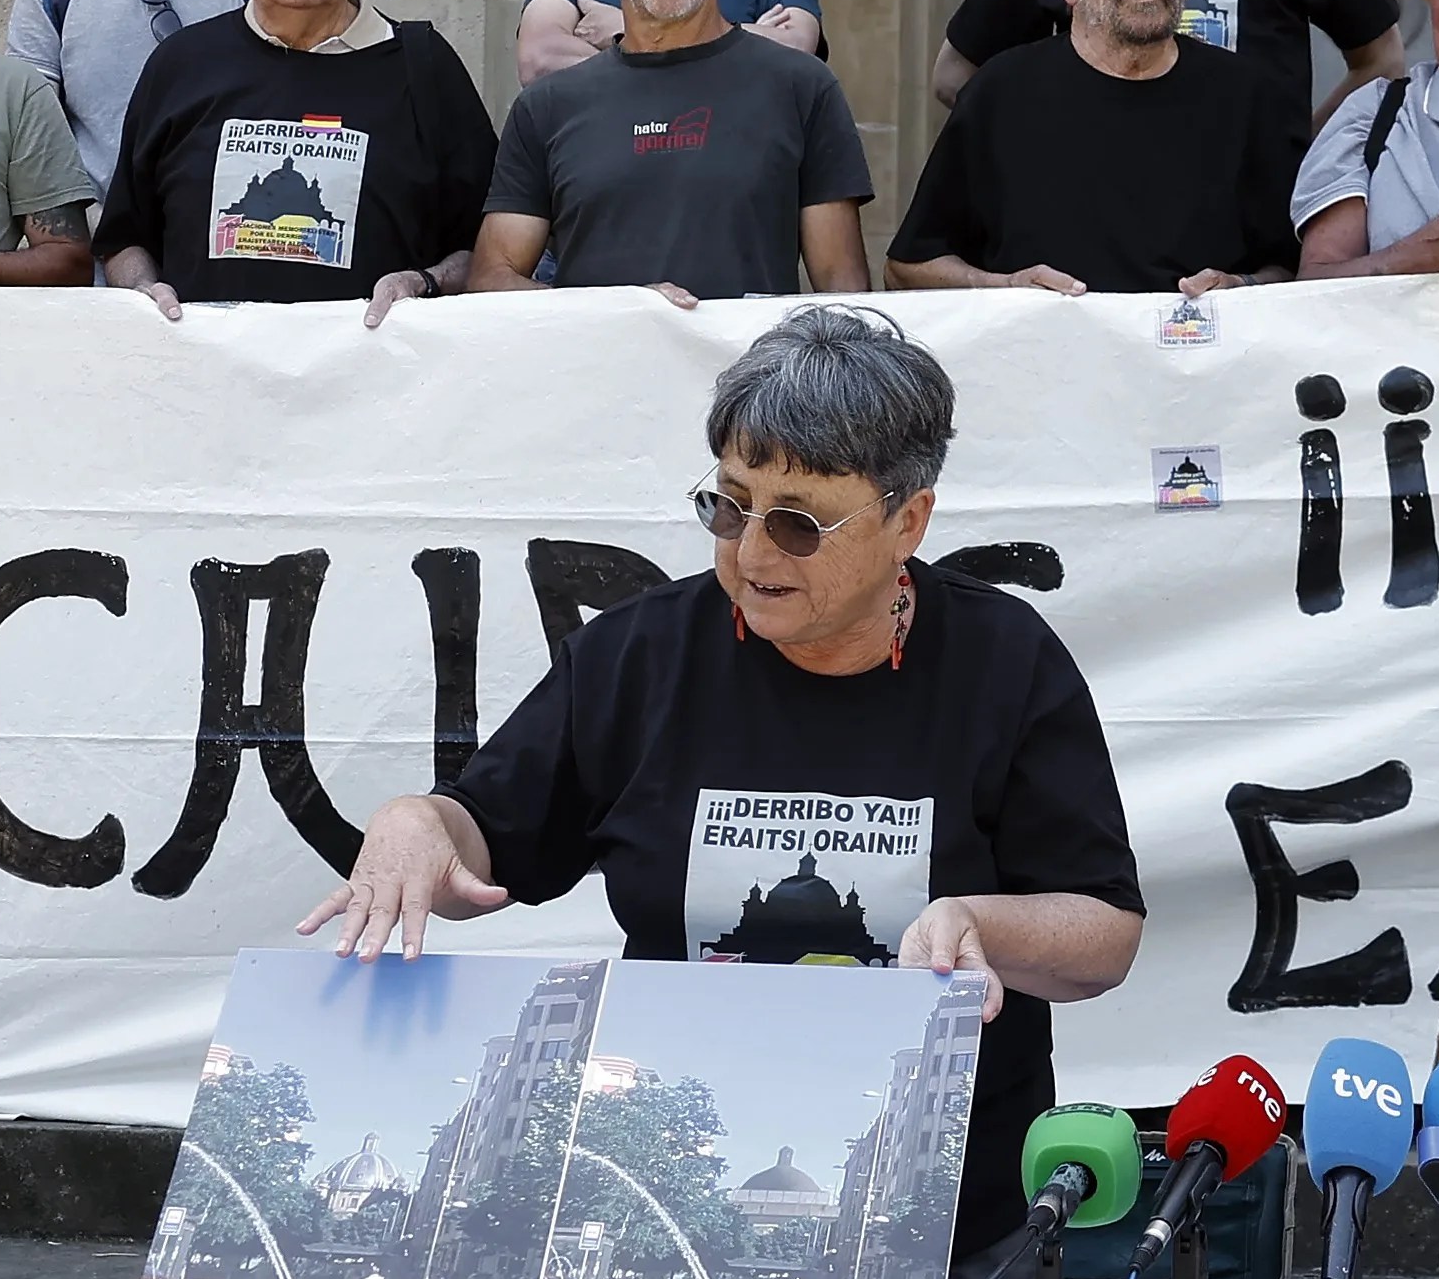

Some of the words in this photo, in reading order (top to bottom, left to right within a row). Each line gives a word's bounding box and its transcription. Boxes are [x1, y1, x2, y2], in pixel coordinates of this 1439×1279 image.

[228, 123, 318, 140] ¡¡¡DERRIBO
[323, 130, 361, 146] YA!!!
[633, 121, 669, 135] hator
[225, 140, 287, 156] ERAITSI
[292, 142, 358, 162] ORAIN!!!
[706, 797, 854, 822] ¡¡¡DERRIBO
[863, 802, 922, 827] YA!!!
[702, 824, 806, 852] ERAITSI
[813, 829, 919, 856] ORAIN!!!
[1237, 1070, 1281, 1123] rne
[1332, 1067, 1403, 1117] tve
